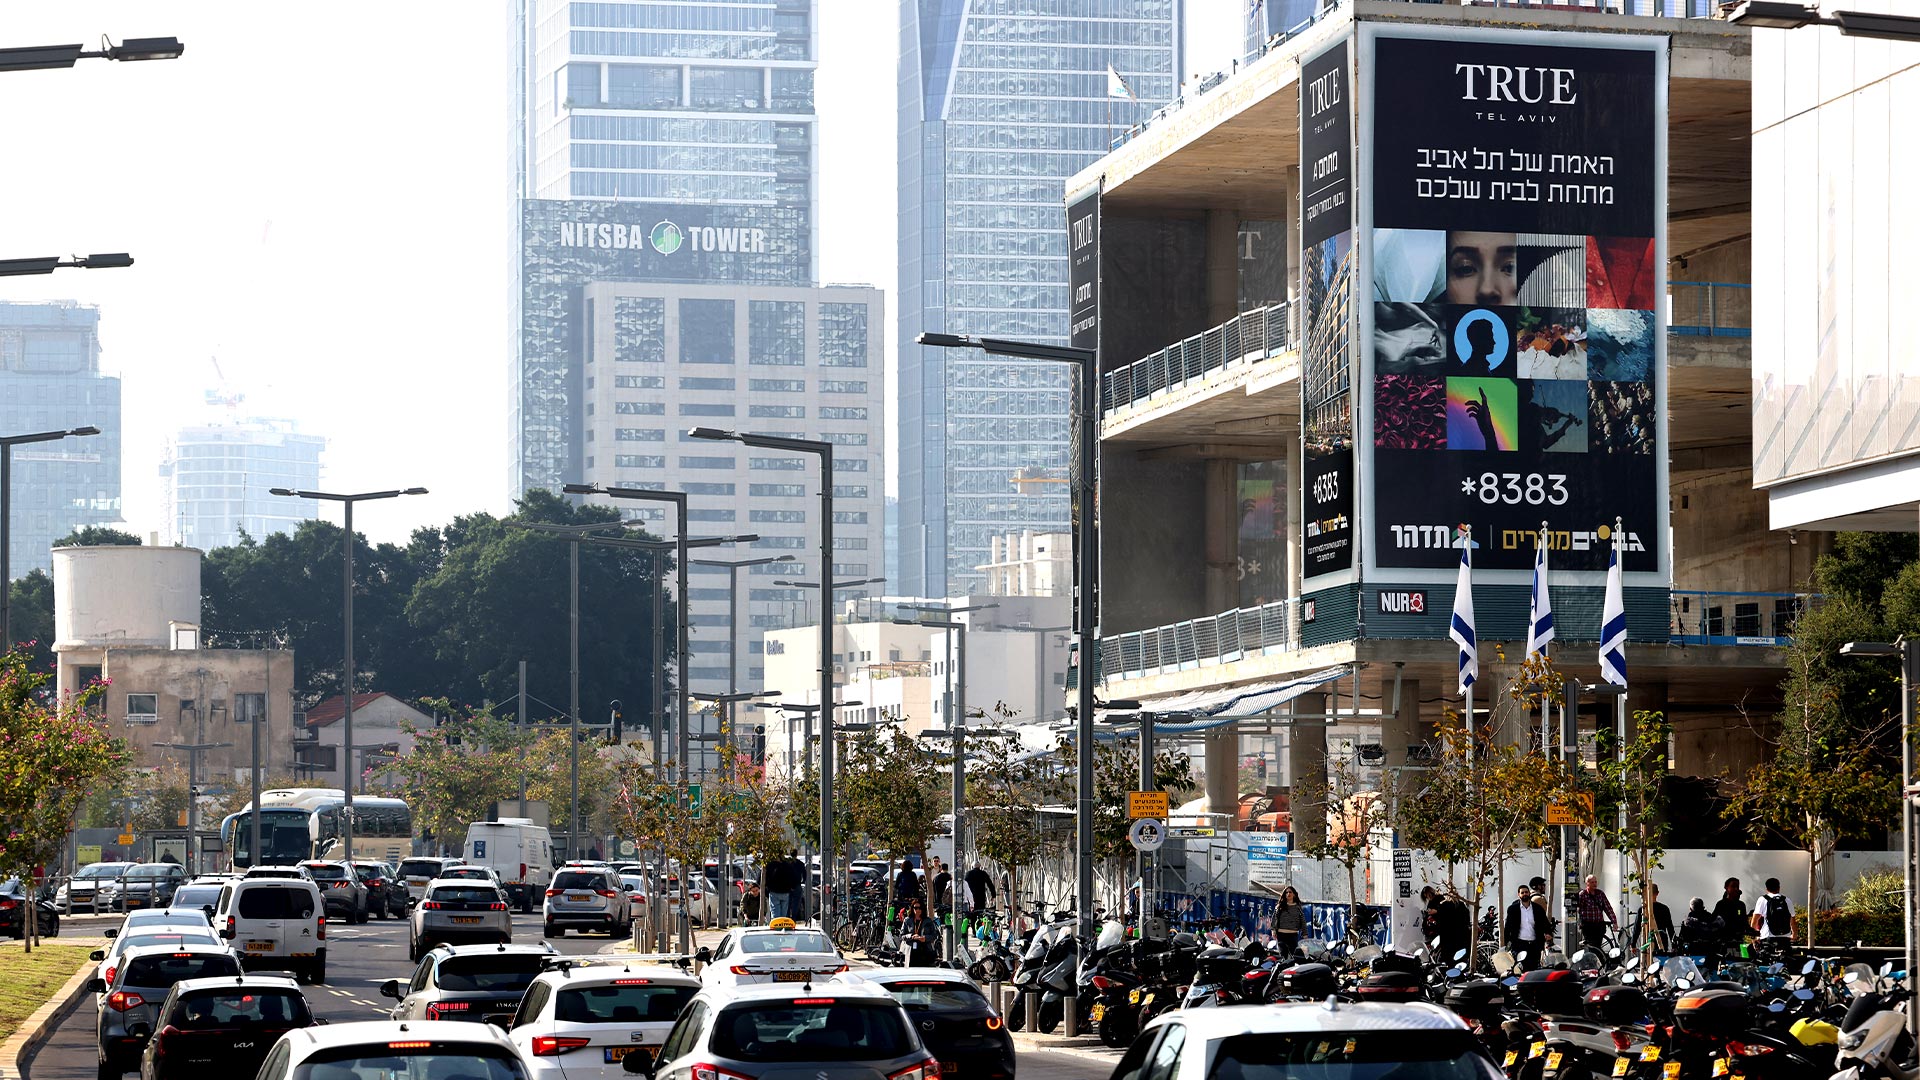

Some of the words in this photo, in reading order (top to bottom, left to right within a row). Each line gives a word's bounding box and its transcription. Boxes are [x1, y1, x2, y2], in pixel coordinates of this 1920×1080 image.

[1309, 67, 1340, 117] TRUE
[1455, 63, 1577, 105] TRUE
[1476, 112, 1507, 122] TEL
[1518, 114, 1556, 123] AVIV
[1416, 148, 1467, 170] אביב
[1473, 147, 1504, 170] תל
[1510, 148, 1543, 172] של
[1548, 154, 1614, 175] האמת
[1416, 176, 1481, 200] שלכם
[1488, 178, 1539, 202] לבית
[1547, 184, 1614, 205] מתחת
[560, 221, 643, 250] NITSBA
[688, 226, 766, 253] TOWER
[1072, 212, 1094, 252] TRUE
[1390, 525, 1450, 549] תדהר
